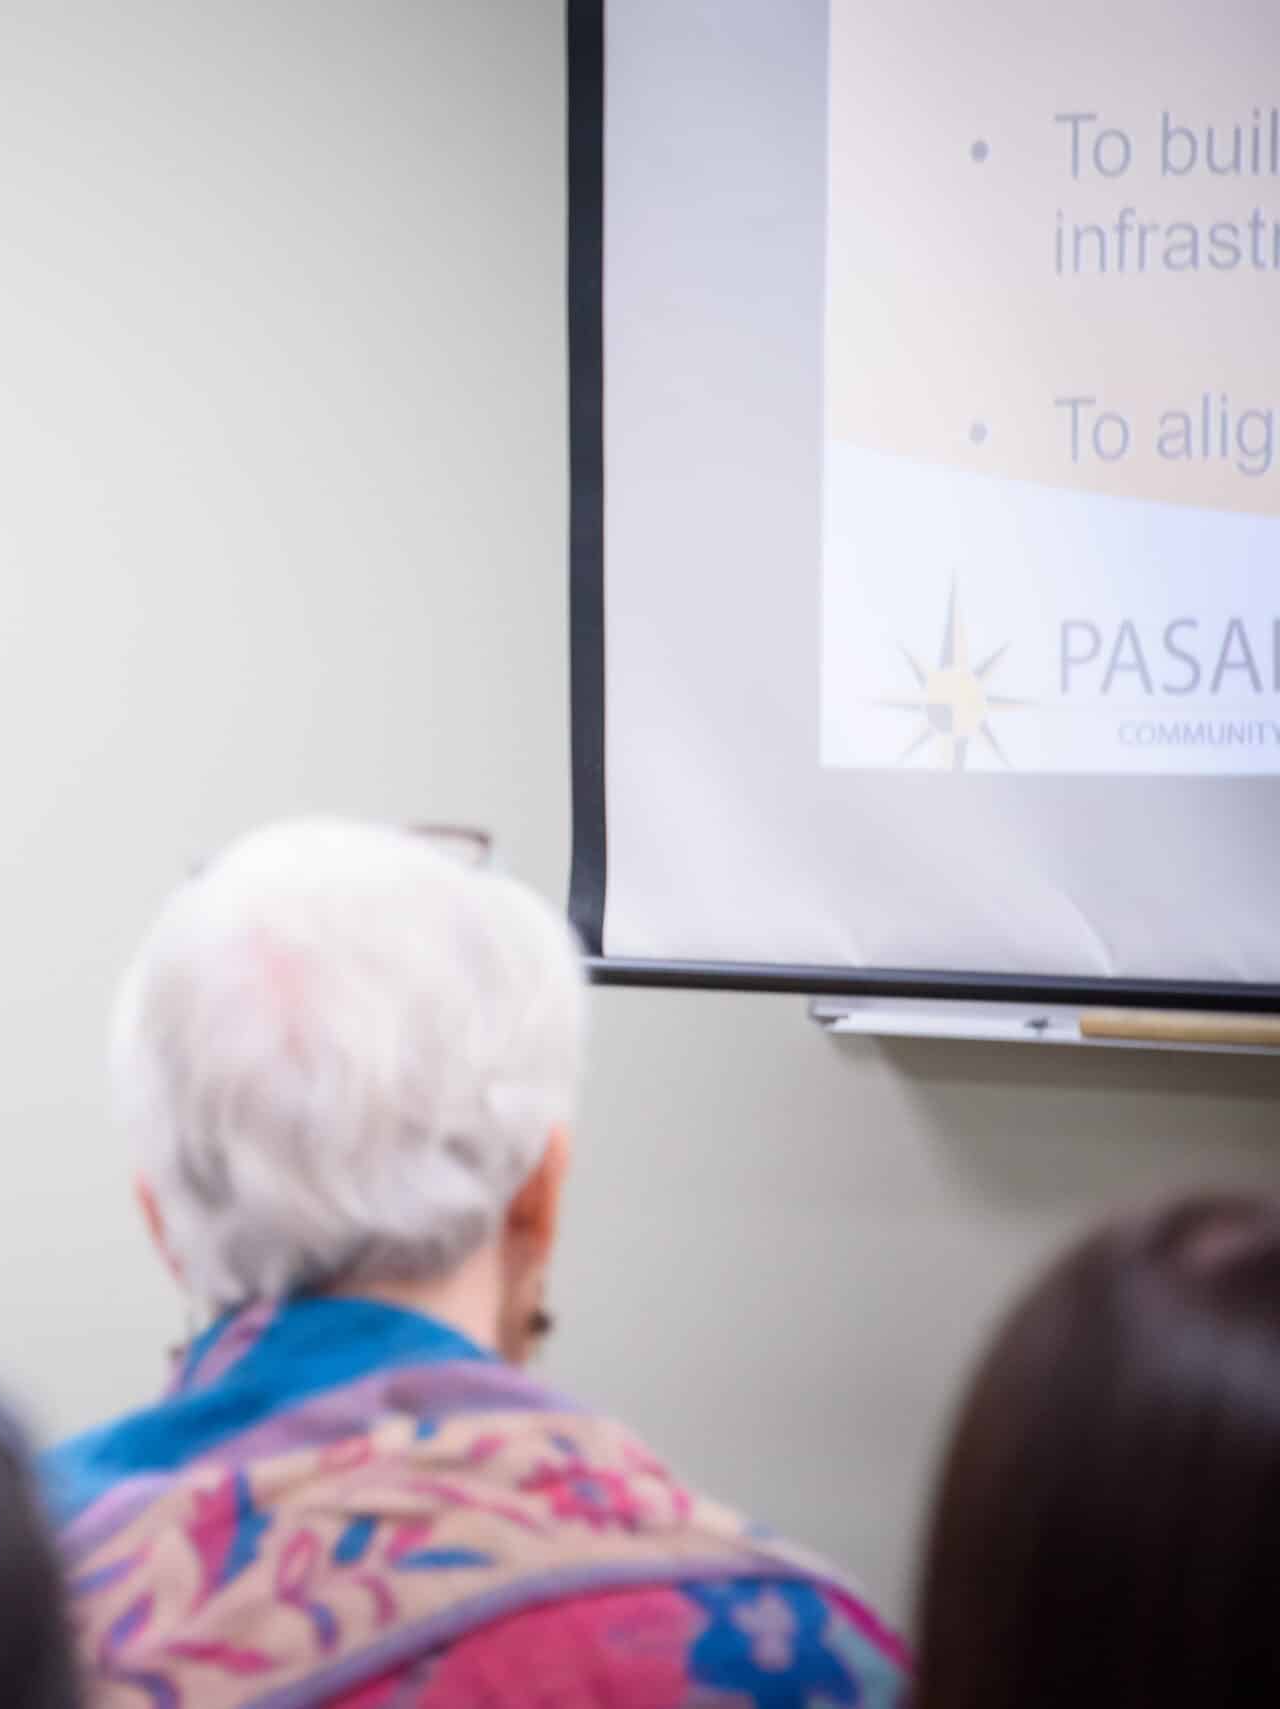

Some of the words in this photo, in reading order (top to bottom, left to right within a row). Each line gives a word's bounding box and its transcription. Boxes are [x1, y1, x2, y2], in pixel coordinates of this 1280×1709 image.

[1053, 111, 1131, 178] To
[1160, 106, 1280, 177] buil
[1053, 396, 1130, 461] To
[1156, 392, 1274, 478] alig
[1060, 617, 1280, 696] PASA
